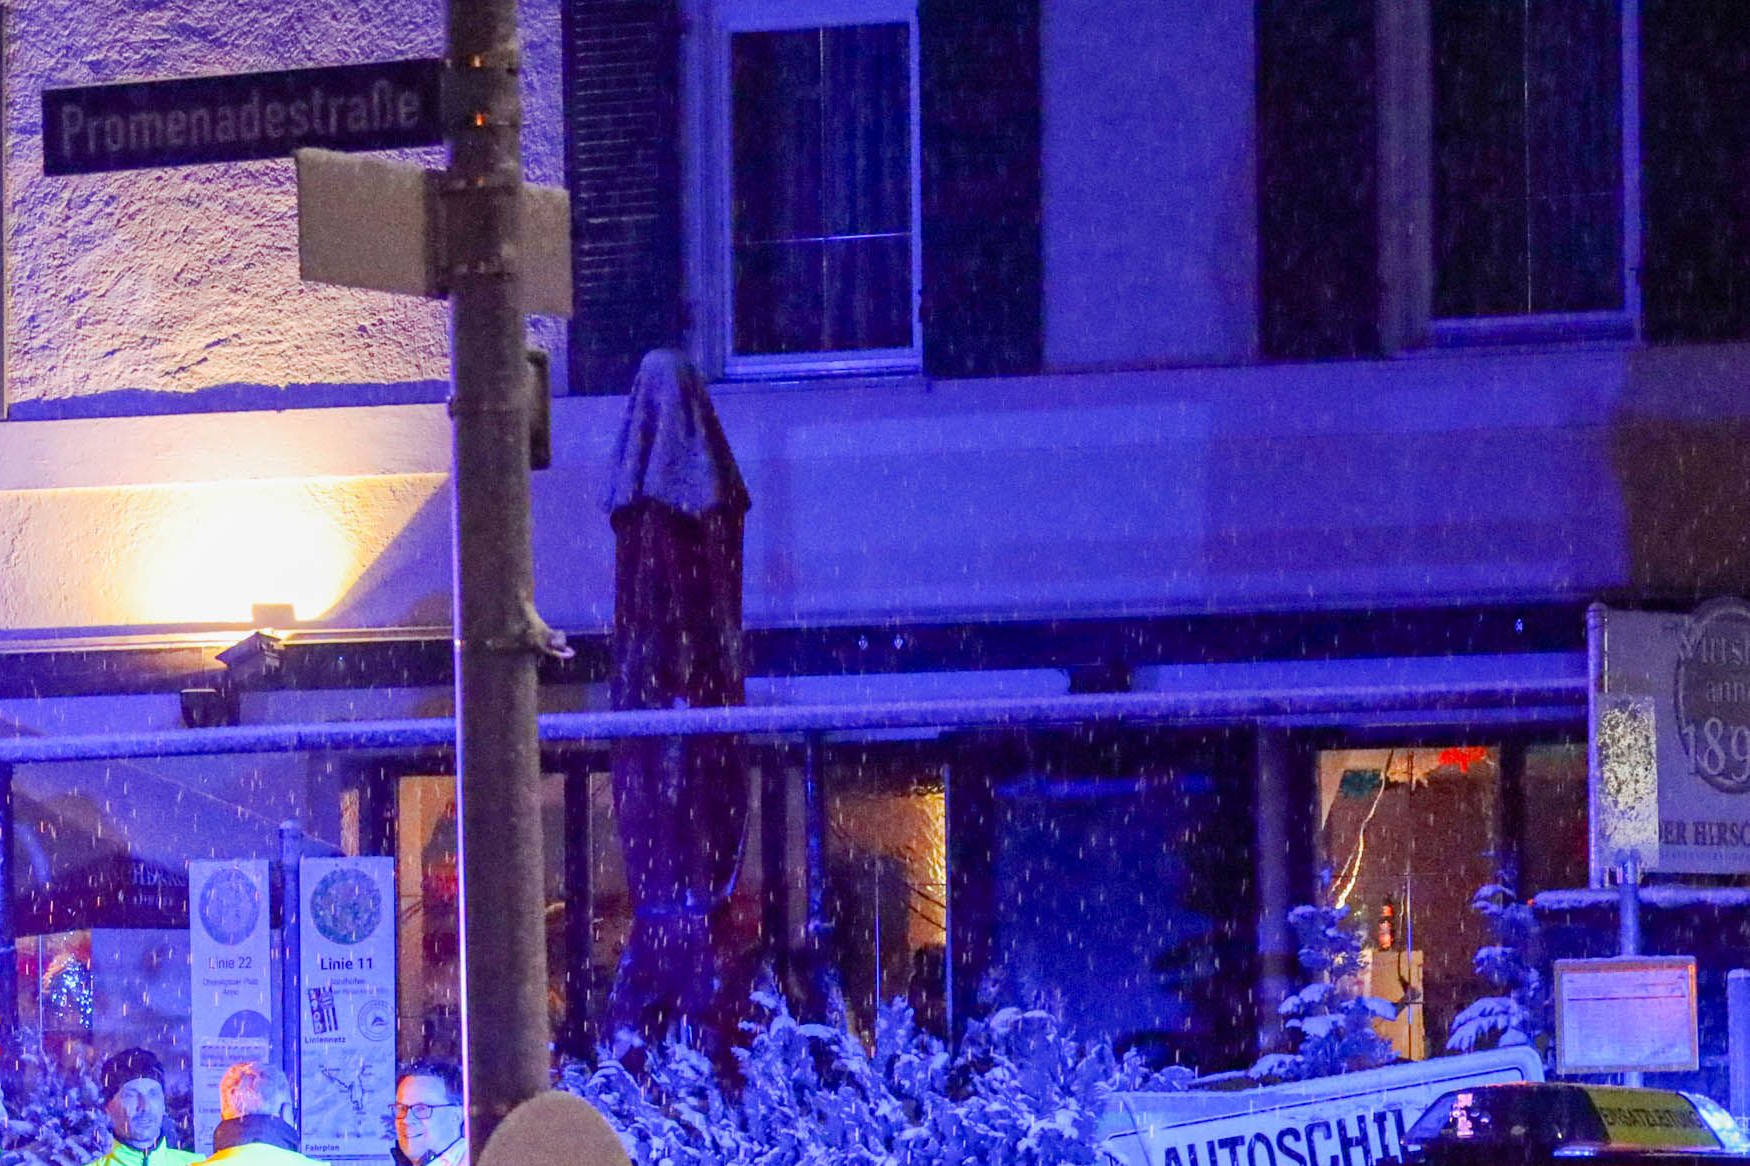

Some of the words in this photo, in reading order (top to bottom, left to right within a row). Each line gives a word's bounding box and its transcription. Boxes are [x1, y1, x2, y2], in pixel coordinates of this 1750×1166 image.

[61, 79, 421, 158] Promenadestraße
[1705, 680, 1750, 704] ann
[1658, 820, 1687, 846] ER
[208, 957, 235, 970] Linie
[238, 957, 253, 970] 22
[321, 957, 353, 970] Linie
[359, 957, 373, 970] 11
[305, 1143, 340, 1152] Fahrplan
